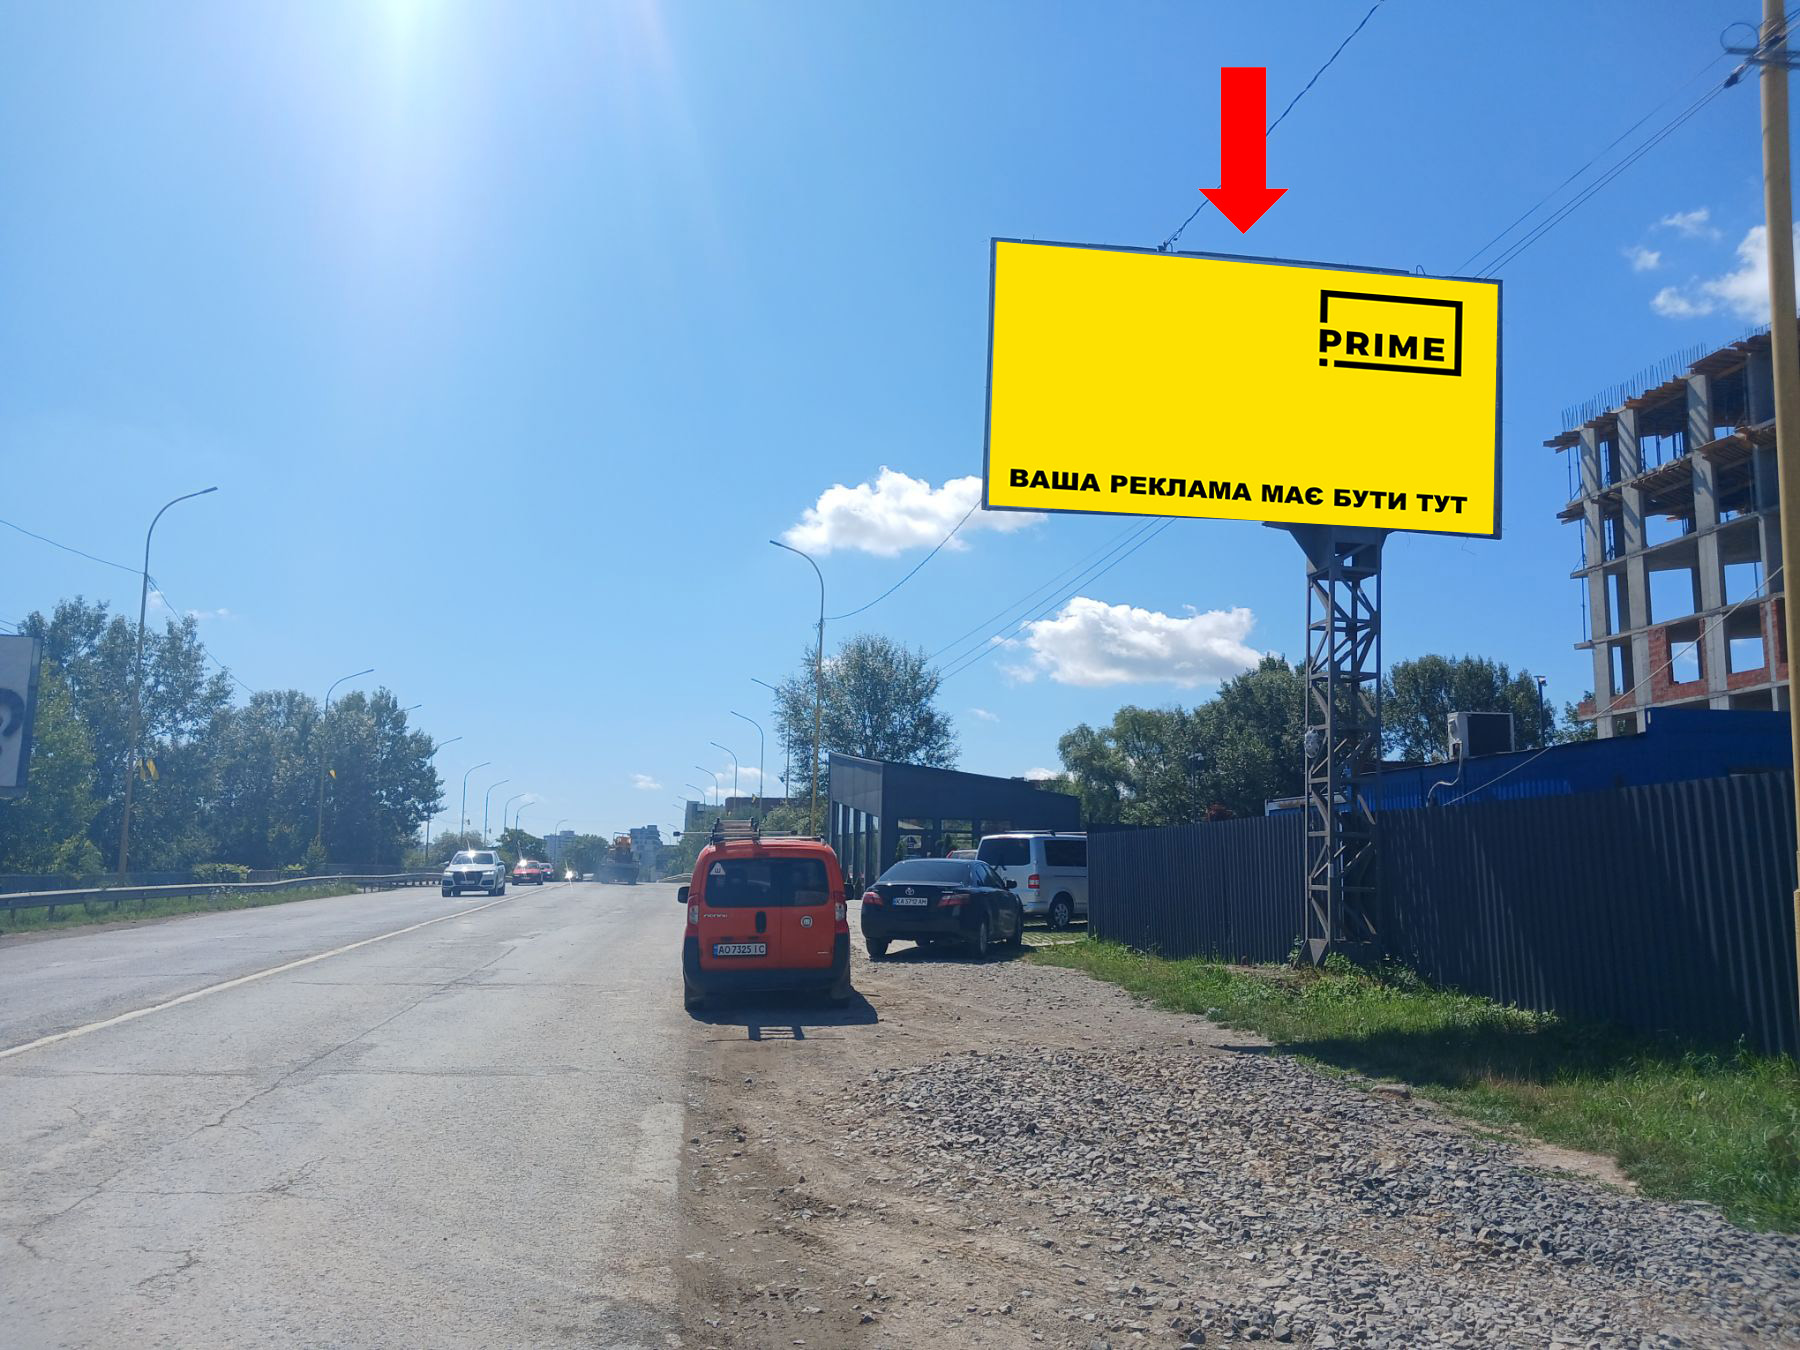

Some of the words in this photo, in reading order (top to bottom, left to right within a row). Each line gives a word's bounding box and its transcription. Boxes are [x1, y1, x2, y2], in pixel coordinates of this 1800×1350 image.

[1319, 328, 1445, 362] PRIME
[1009, 468, 1101, 492] ВАША
[1110, 474, 1252, 502] РЕКЛАМА
[1261, 484, 1324, 506] МАЄ
[1333, 488, 1407, 511] БУТИ
[1416, 493, 1468, 514] ТУТ
